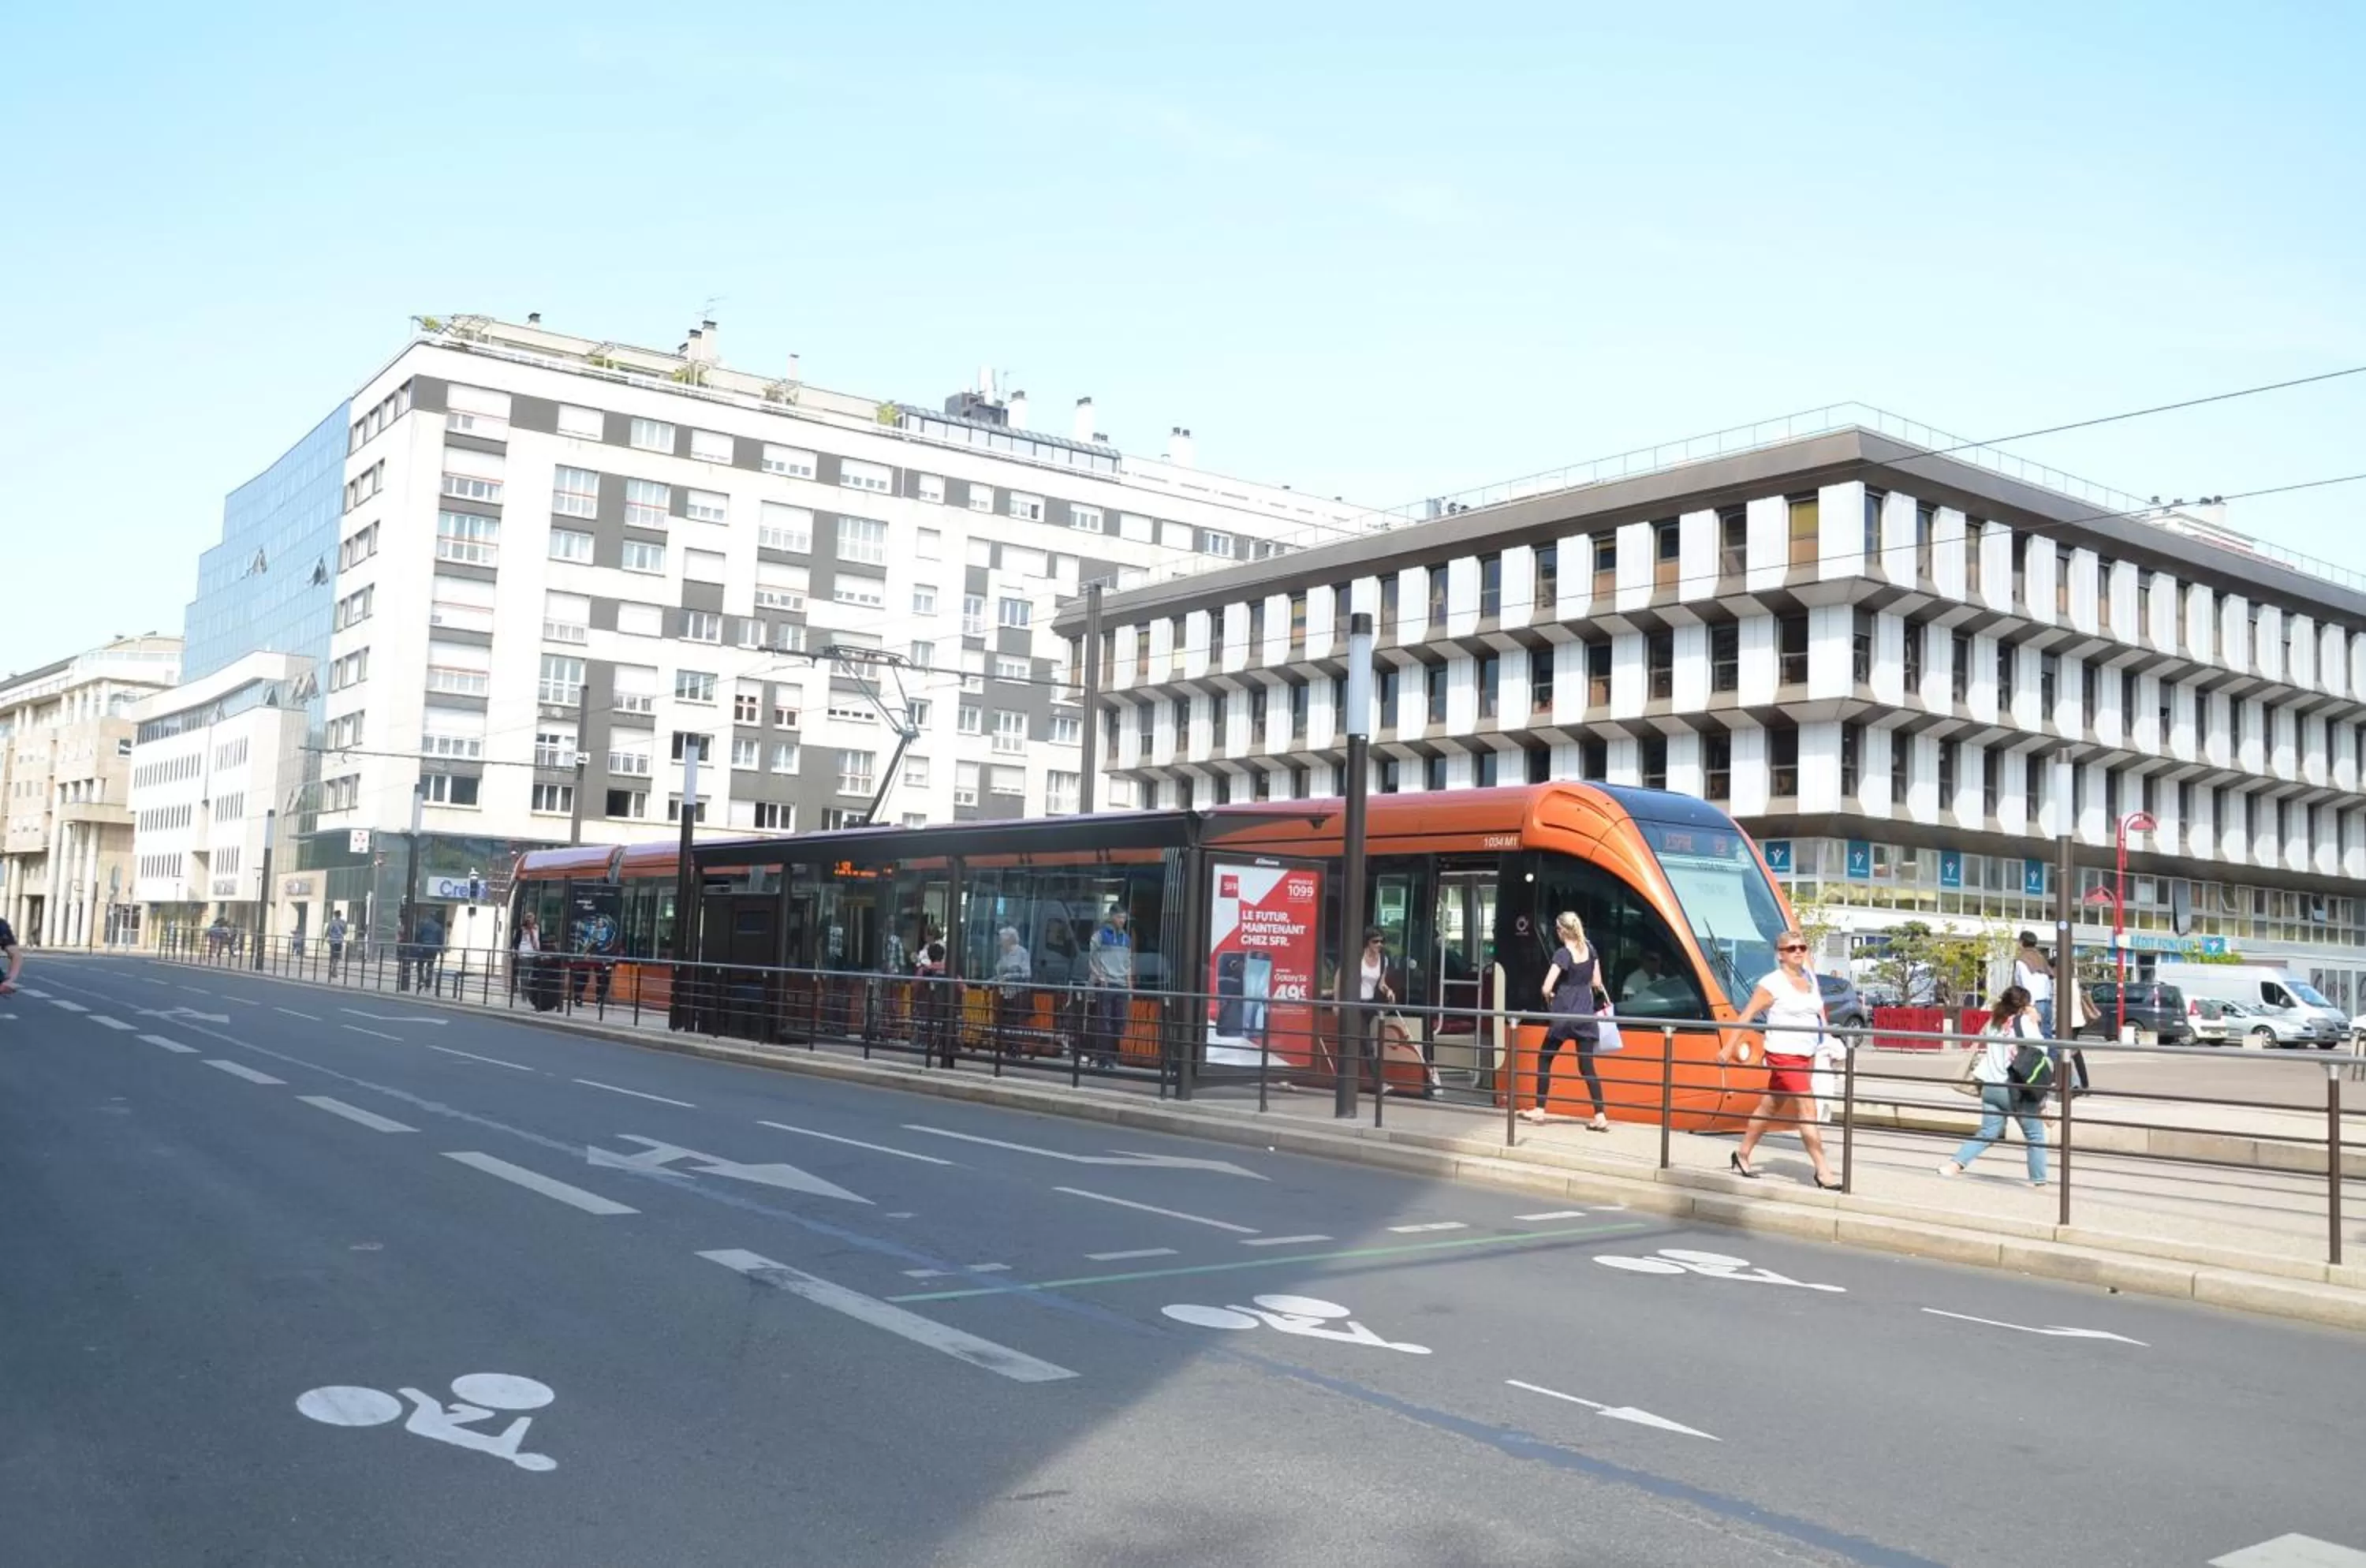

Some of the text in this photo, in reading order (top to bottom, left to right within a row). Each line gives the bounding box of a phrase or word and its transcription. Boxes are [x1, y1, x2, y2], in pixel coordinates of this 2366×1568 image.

[1287, 884, 1314, 897] 1099
[1242, 909, 1290, 923] LE FUTUR,
[1241, 922, 1306, 935] MAINTENANT
[1241, 935, 1290, 946] CHEZ SFR.
[1274, 984, 1307, 1000] 49€
